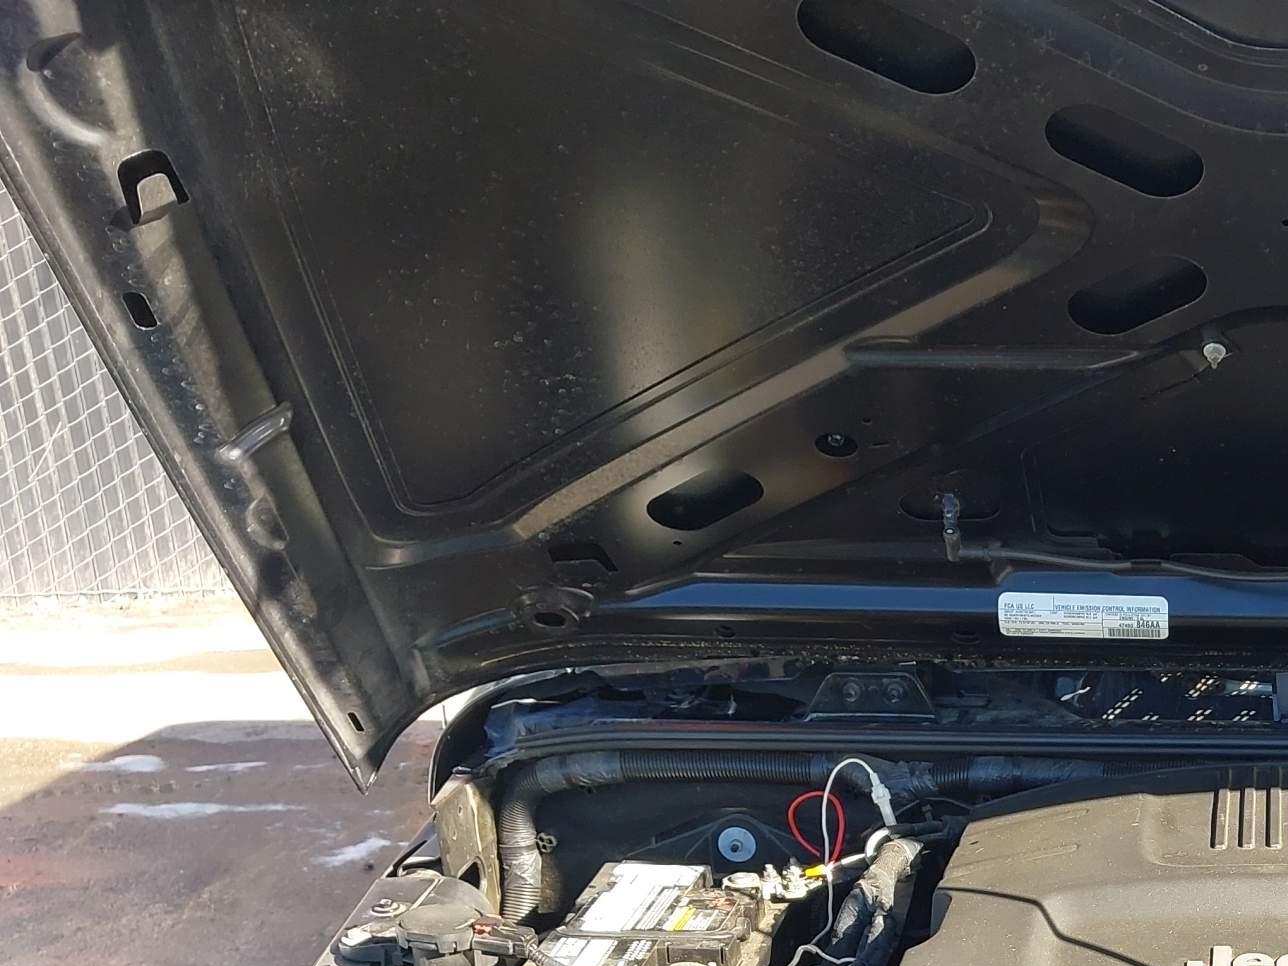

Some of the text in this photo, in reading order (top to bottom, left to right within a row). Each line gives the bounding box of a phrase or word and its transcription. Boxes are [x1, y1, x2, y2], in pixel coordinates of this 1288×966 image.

[1055, 604, 1076, 612] VEHICLE
[1076, 604, 1101, 612] EMISSION
[1102, 605, 1125, 613] CONTROL
